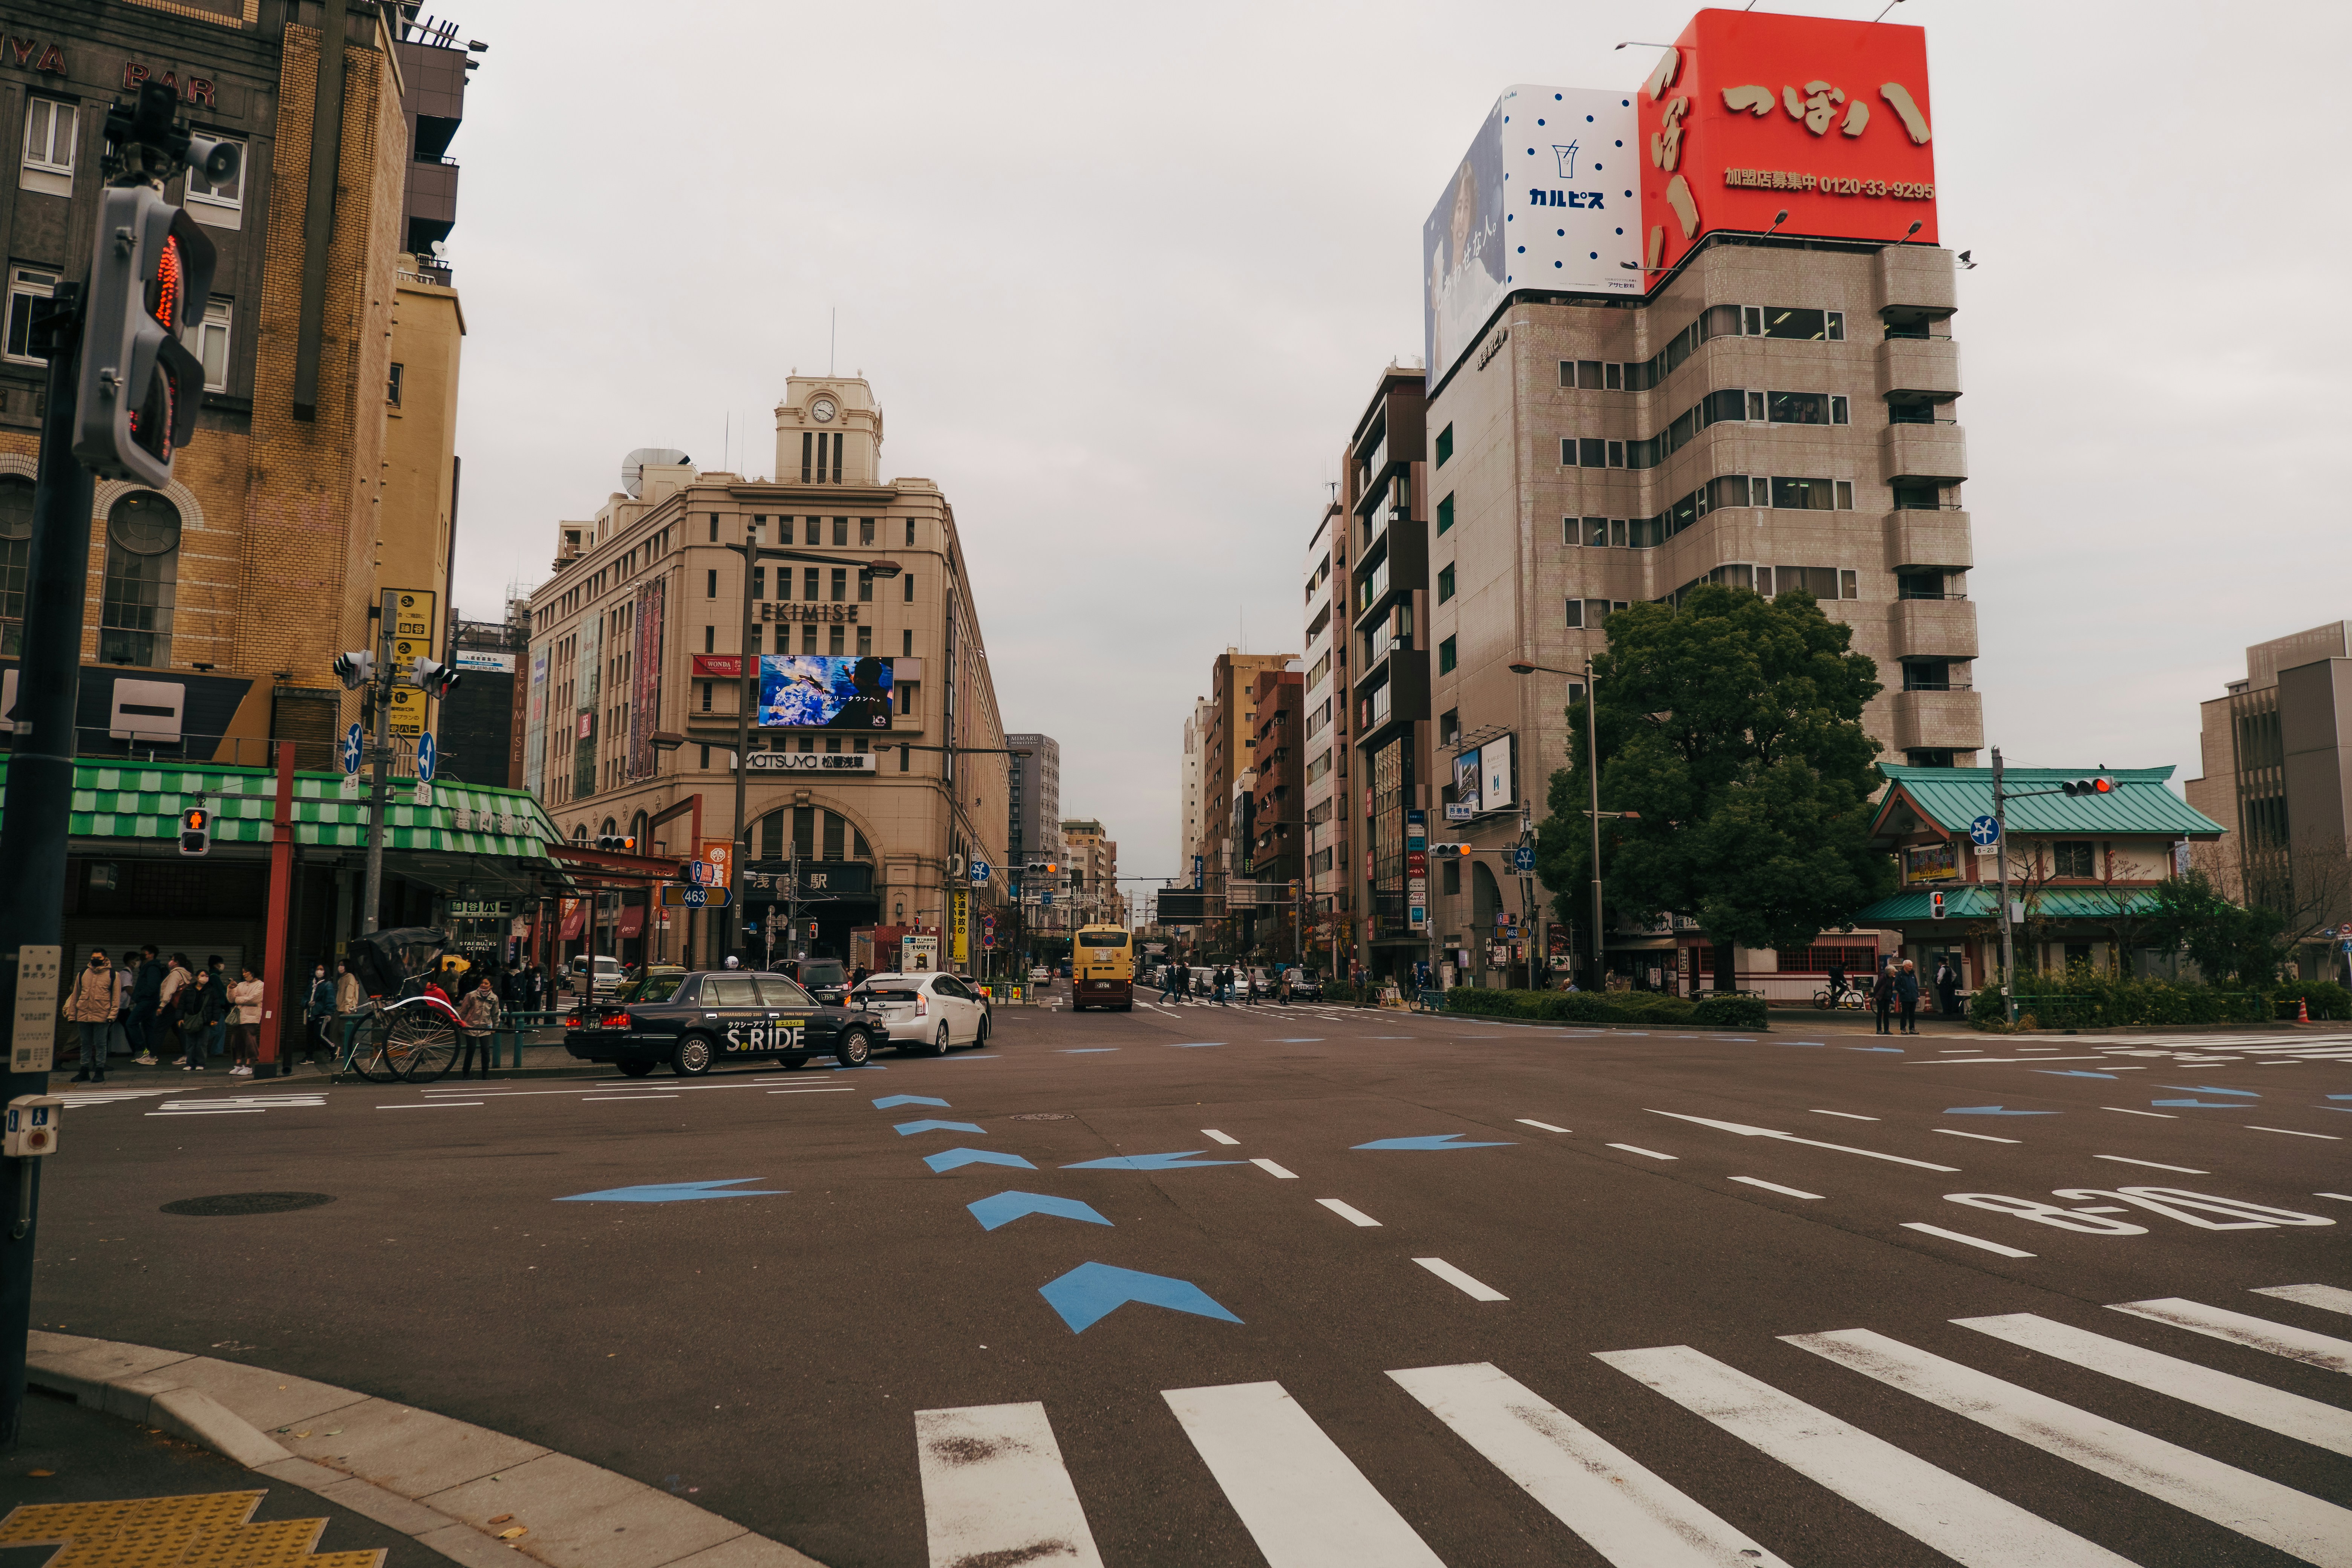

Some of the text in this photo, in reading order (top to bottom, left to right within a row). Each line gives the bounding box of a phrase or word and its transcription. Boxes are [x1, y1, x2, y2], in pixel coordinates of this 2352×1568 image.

[1721, 80, 1932, 145] つぼ八
[1647, 47, 1700, 276] つぼ八
[1724, 167, 1935, 199] 加盟店募集中 0120-33-9295
[1530, 188, 1604, 209] カルピス
[761, 603, 858, 622] EKIMISE
[513, 668, 525, 761] EKIMISE
[822, 756, 864, 768] 松屋浅草
[696, 864, 700, 877] 6
[753, 873, 827, 889] 浅駅
[452, 902, 511, 911] 神谷バー
[684, 891, 705, 902] 463
[1943, 1187, 2337, 1235] 8-20
